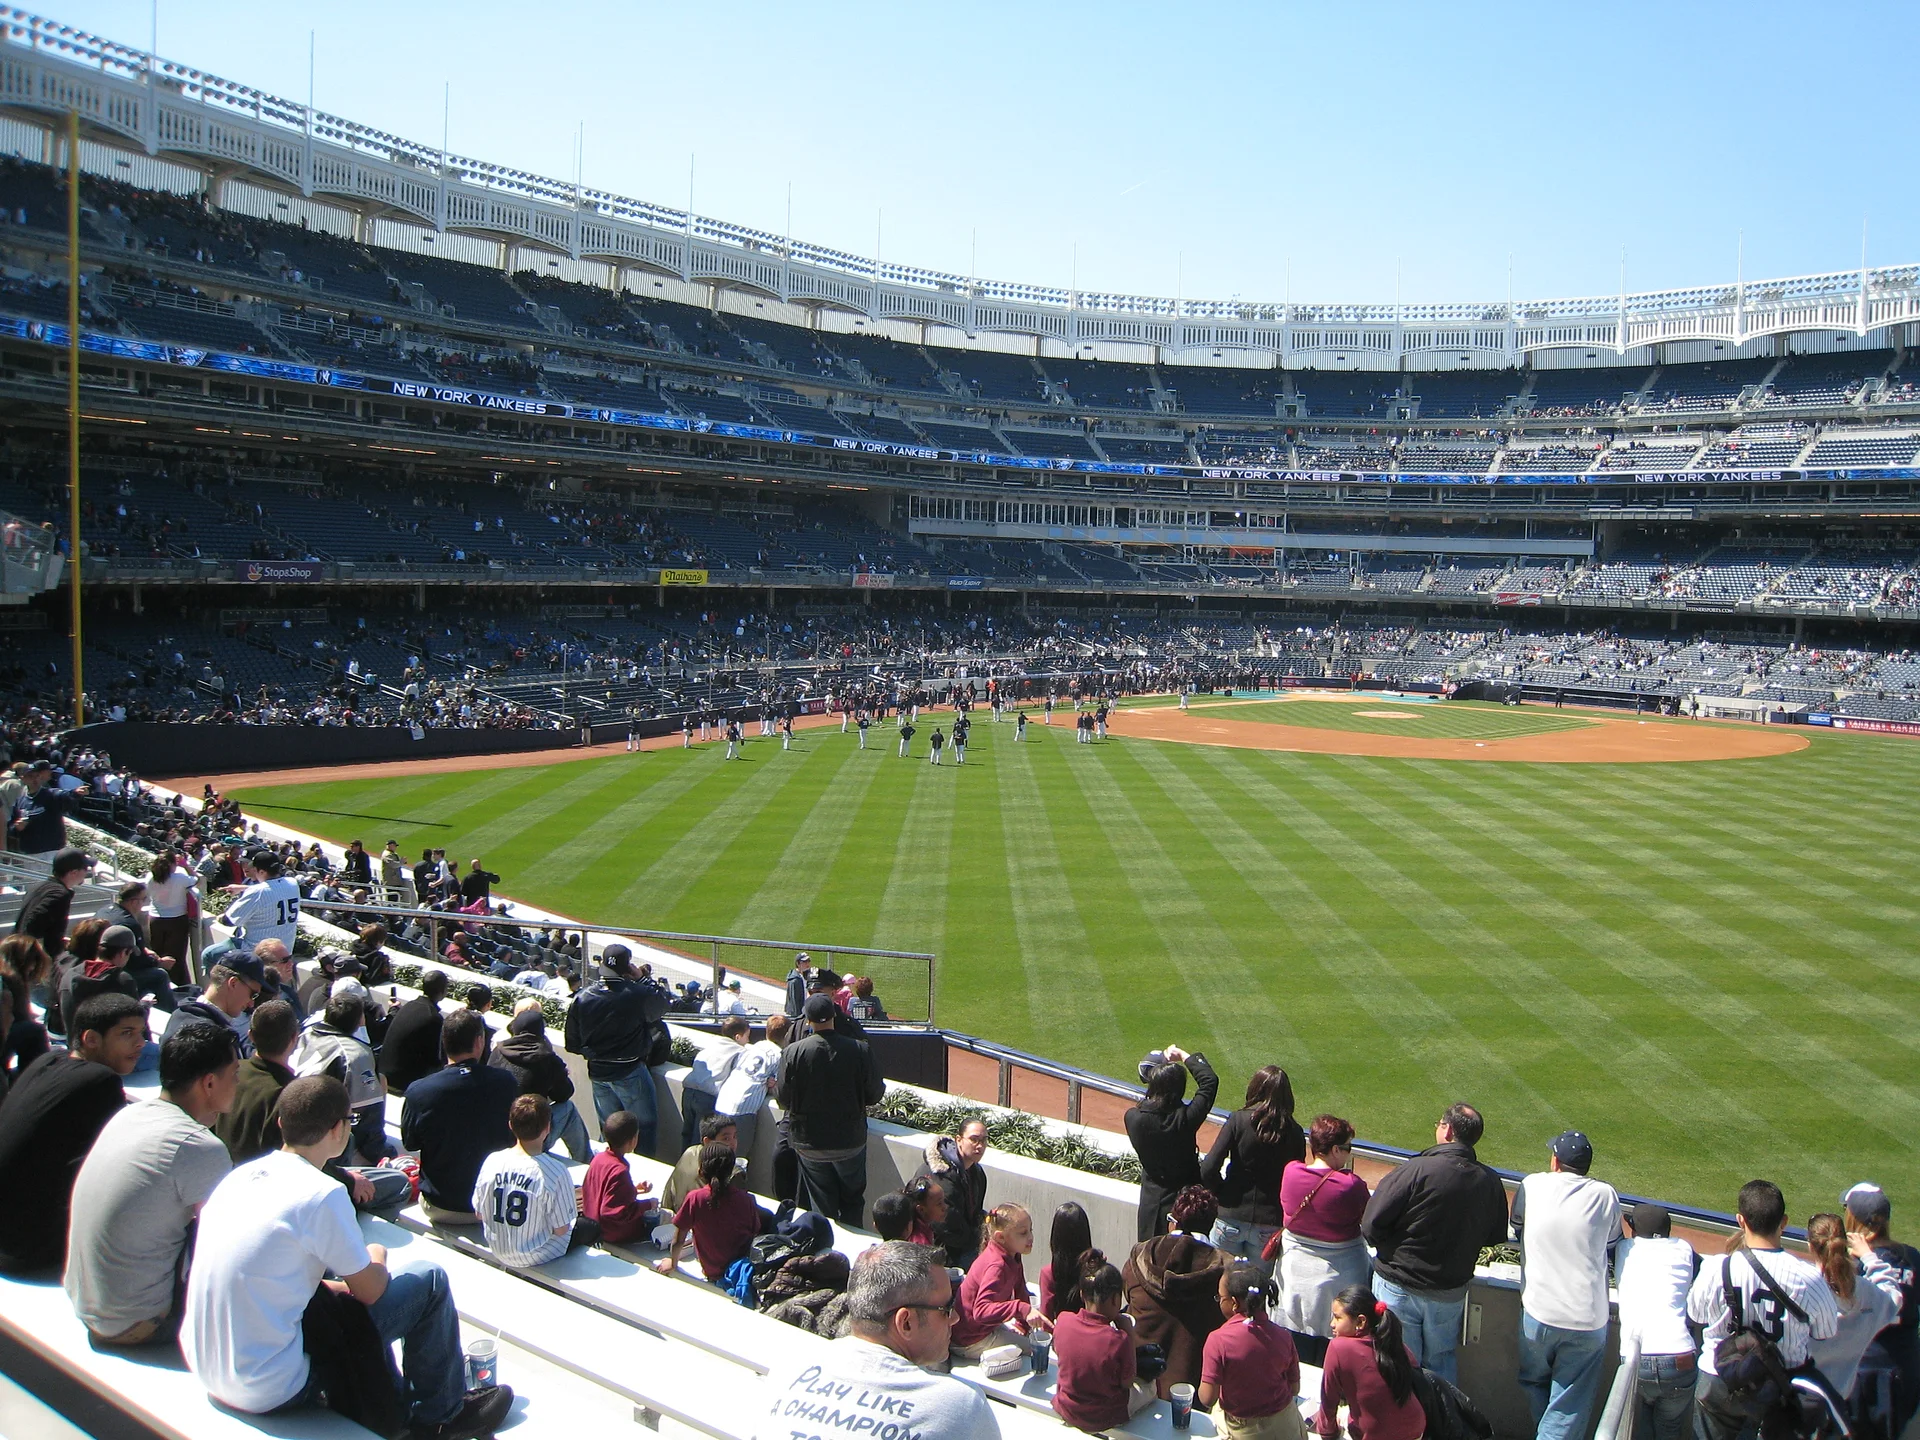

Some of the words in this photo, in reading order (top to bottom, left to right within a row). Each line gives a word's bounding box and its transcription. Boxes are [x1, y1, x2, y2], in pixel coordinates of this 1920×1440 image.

[393, 382, 428, 398] NEW
[433, 388, 473, 404] YORK
[477, 395, 547, 414] YANKEES
[833, 438, 858, 450] NEW
[860, 441, 889, 454] YORK
[891, 446, 939, 459] YANKEES
[1202, 469, 1232, 478] NEW
[1235, 470, 1271, 480] YORK
[1275, 472, 1341, 482] YANKEES
[1635, 473, 1665, 482] NEW
[1668, 473, 1707, 482] YORK
[1711, 471, 1782, 481] YANKEES
[264, 566, 312, 579] Stop&Shop
[665, 570, 703, 581] Nathan's
[277, 898, 299, 925] 15
[495, 1172, 533, 1189] DAMON
[493, 1187, 529, 1227] 18
[789, 1365, 853, 1401] PLAY
[856, 1390, 915, 1418] LIKE
[770, 1399, 782, 1417] A
[784, 1399, 922, 1440] CHAMPION
